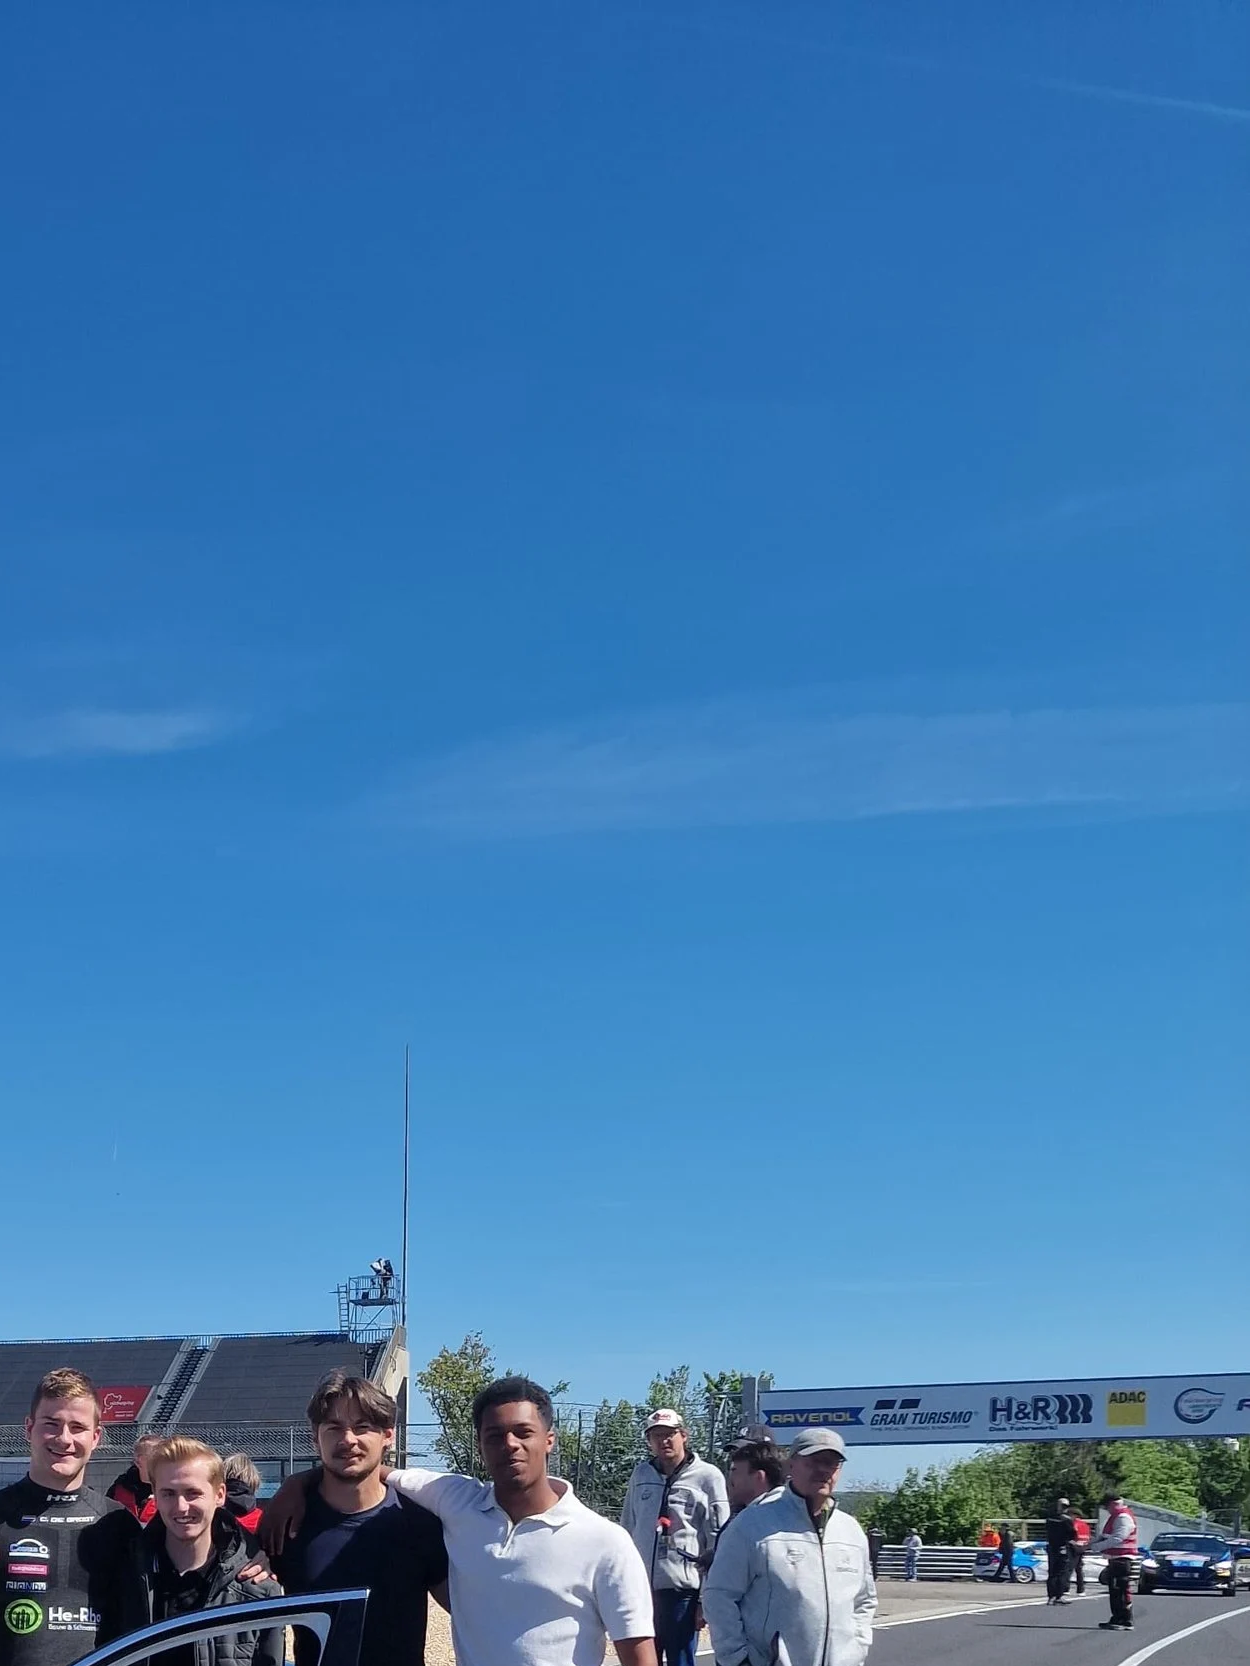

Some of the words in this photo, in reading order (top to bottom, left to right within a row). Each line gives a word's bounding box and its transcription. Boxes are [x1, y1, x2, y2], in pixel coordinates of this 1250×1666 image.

[1109, 1391, 1146, 1404] ADAC
[990, 1395, 1054, 1424] H&R
[770, 1412, 857, 1424] RAVENOL
[870, 1412, 910, 1426] GRAN
[912, 1410, 973, 1425] TURISMO
[48, 1606, 101, 1622] He-Rho
